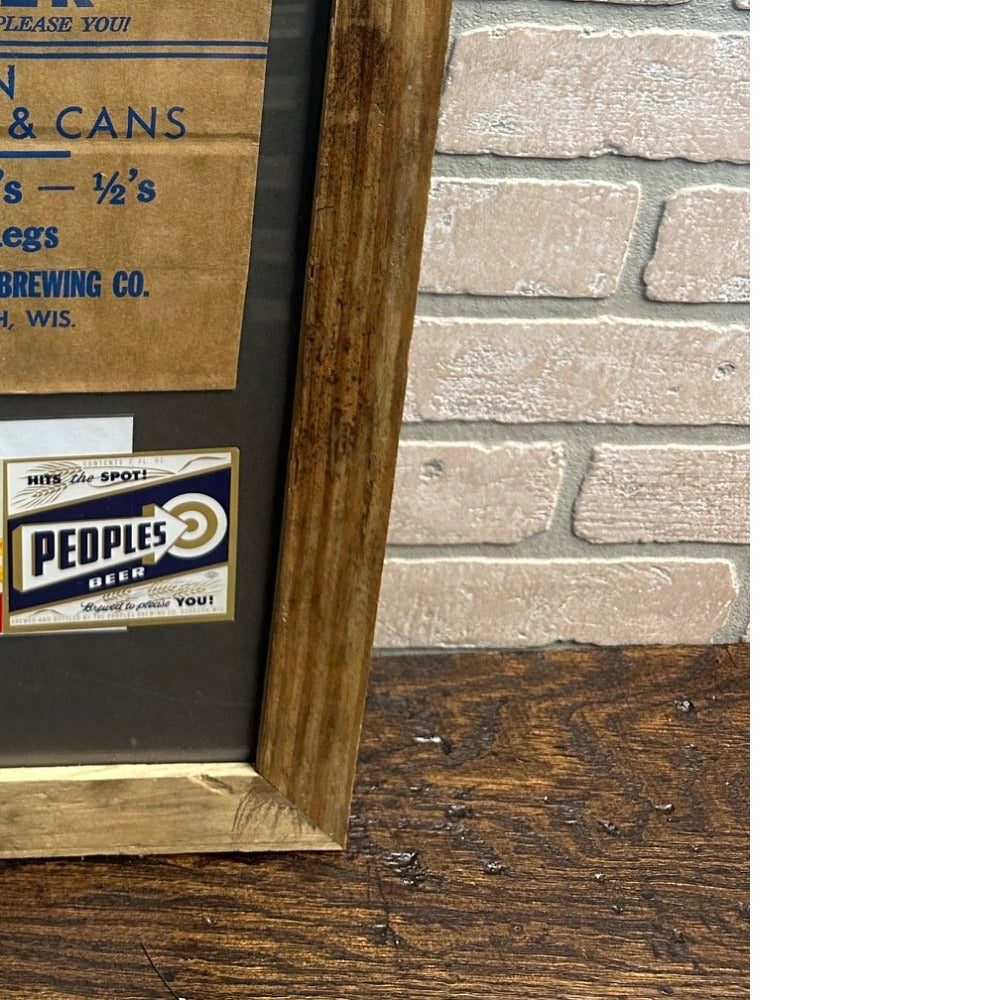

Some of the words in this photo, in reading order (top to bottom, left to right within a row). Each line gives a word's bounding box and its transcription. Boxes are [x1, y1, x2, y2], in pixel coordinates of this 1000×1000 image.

[80, 16, 131, 32] YOU!
[8, 106, 37, 140] &
[56, 106, 187, 139] CANS
[112, 270, 150, 298] CO.
[26, 309, 77, 329] WIS.
[27, 473, 62, 485] HITS
[70, 471, 95, 484] the
[100, 469, 147, 482] SPOT!
[31, 521, 167, 577] PEOPLES
[89, 566, 146, 590] BEER
[80, 601, 122, 613] Brewed
[124, 601, 135, 611] to
[135, 600, 171, 612] please
[175, 595, 215, 608] YOU!
